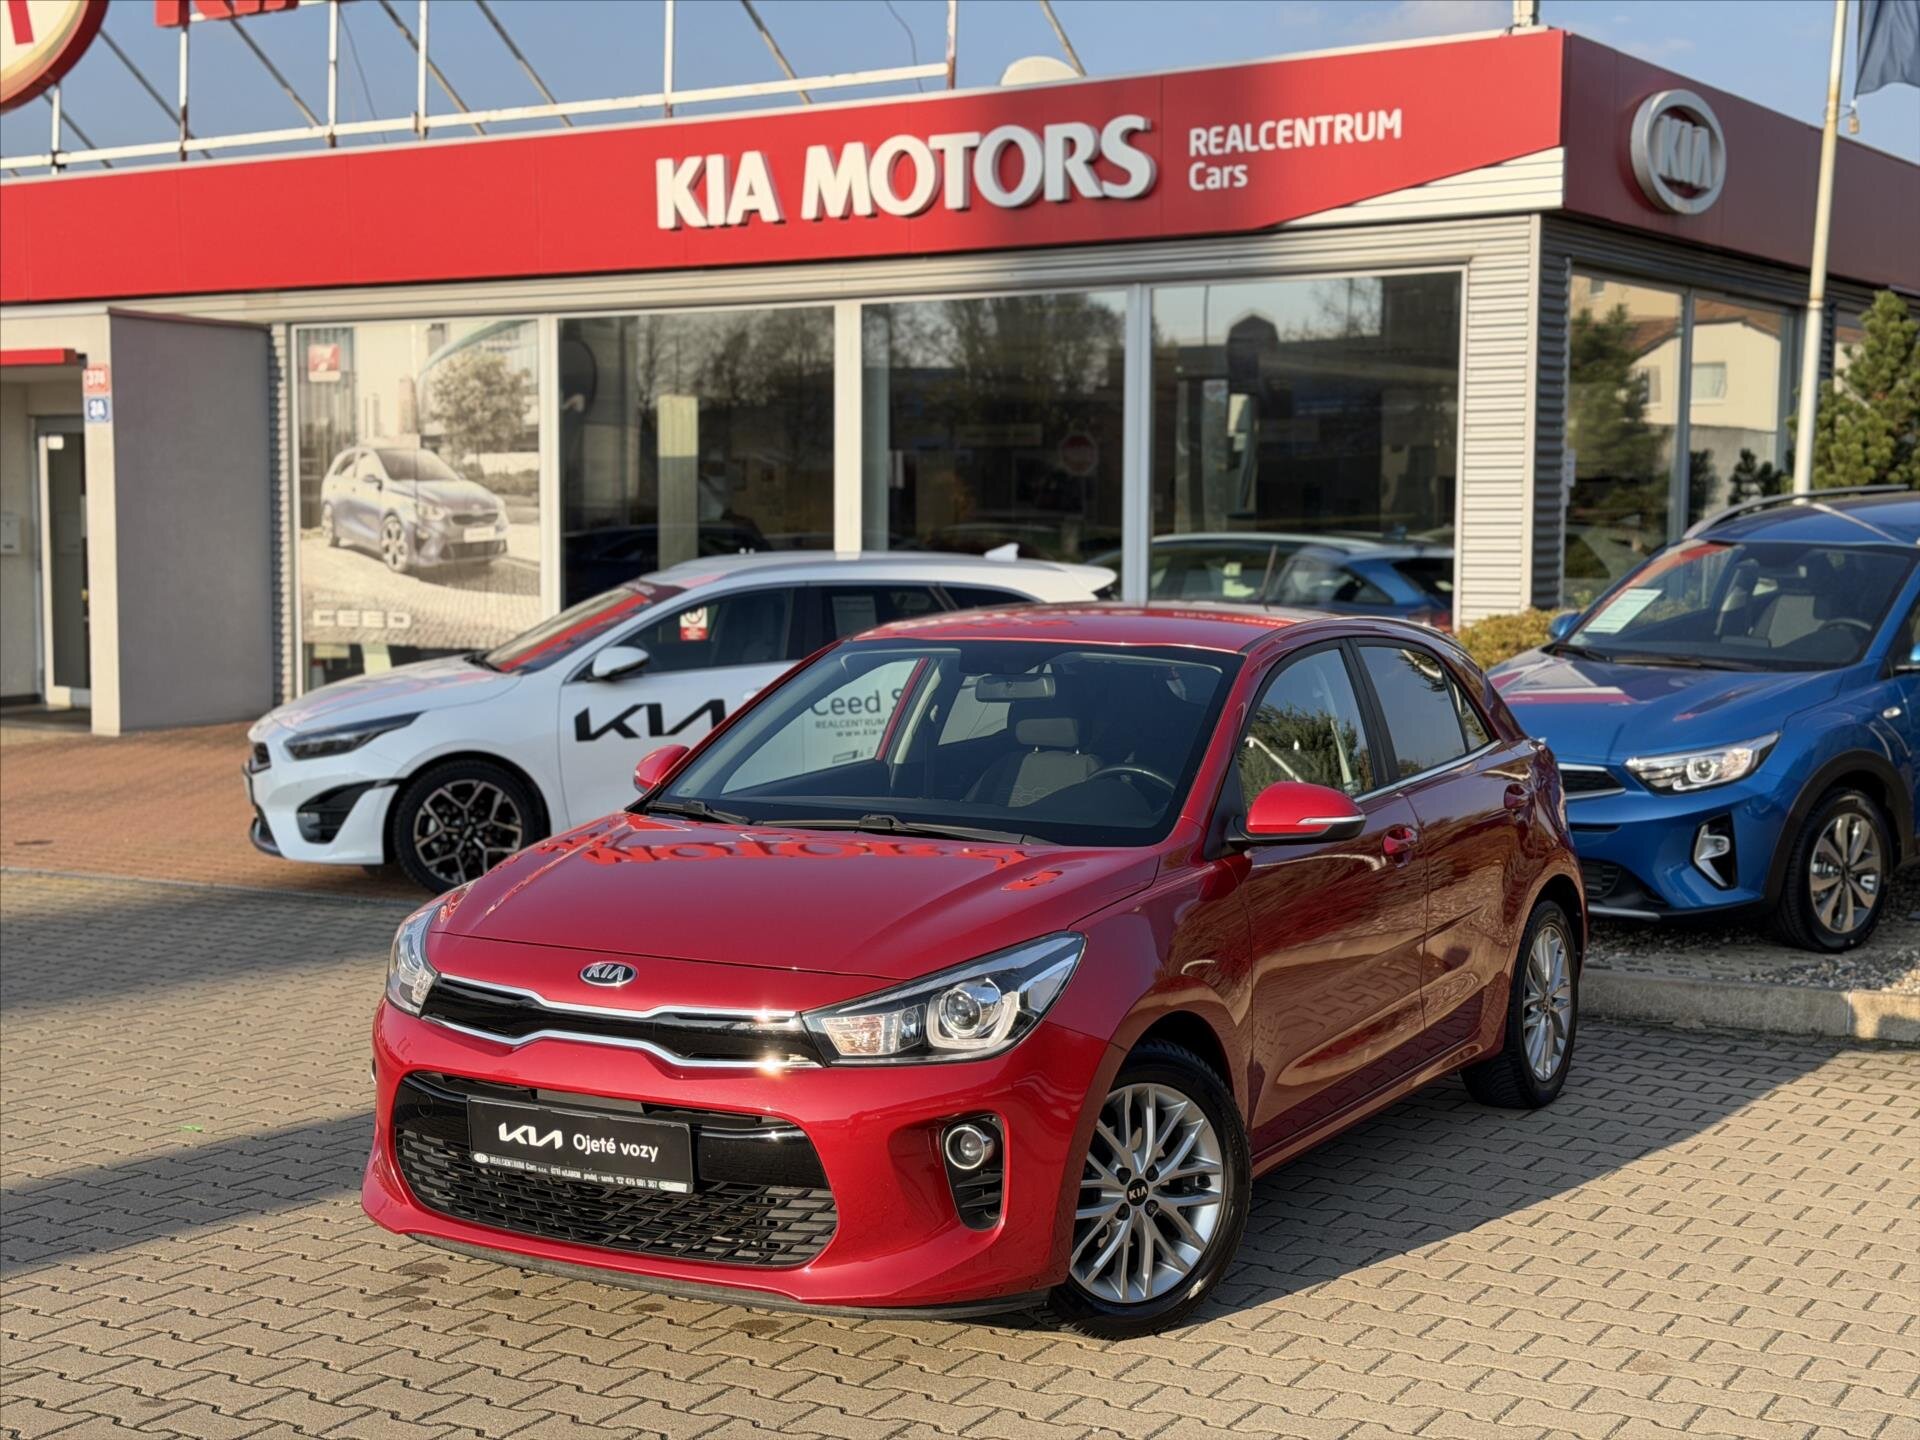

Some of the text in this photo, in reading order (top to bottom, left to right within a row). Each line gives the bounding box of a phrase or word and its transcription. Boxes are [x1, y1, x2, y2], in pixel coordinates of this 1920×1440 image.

[1188, 108, 1403, 157] REALCENTRUM
[1657, 114, 1712, 190] KIA
[655, 114, 1155, 230] KIA MOTORS
[1188, 161, 1248, 191] Cars
[574, 699, 727, 742] KIA
[815, 718, 886, 729] REALCENTRUM
[586, 963, 626, 981] KIA
[498, 1122, 659, 1162] KIA Ojeté vozy
[1128, 1186, 1148, 1200] KIA
